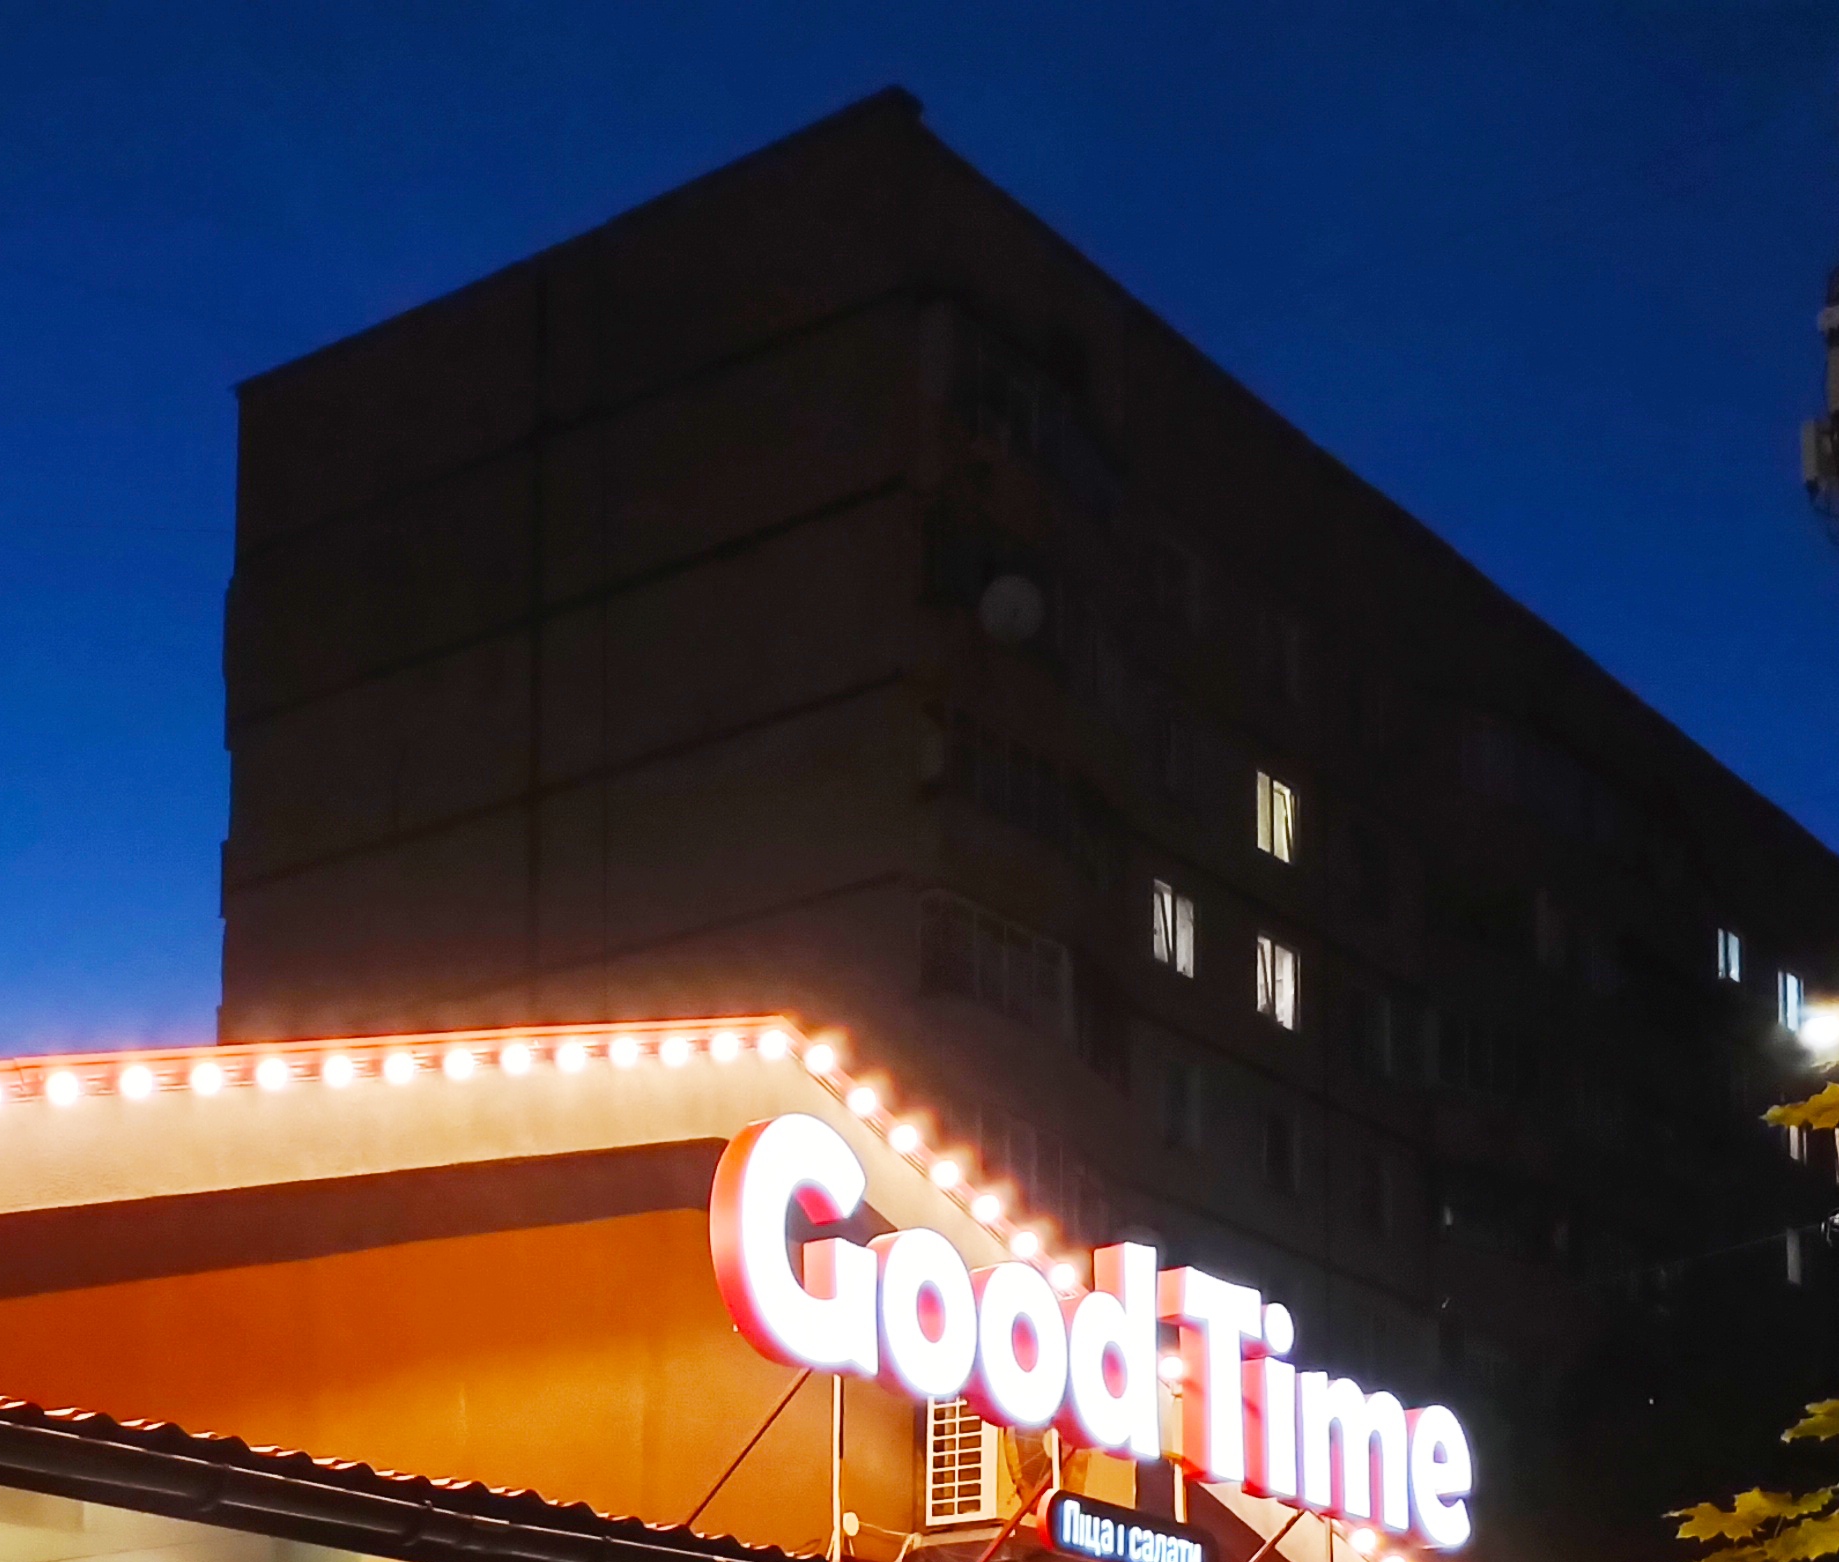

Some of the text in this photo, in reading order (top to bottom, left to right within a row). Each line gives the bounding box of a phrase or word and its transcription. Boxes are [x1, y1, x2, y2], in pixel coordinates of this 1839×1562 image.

[738, 1112, 1474, 1550] Good Time
[1063, 1499, 1115, 1557] Піца
